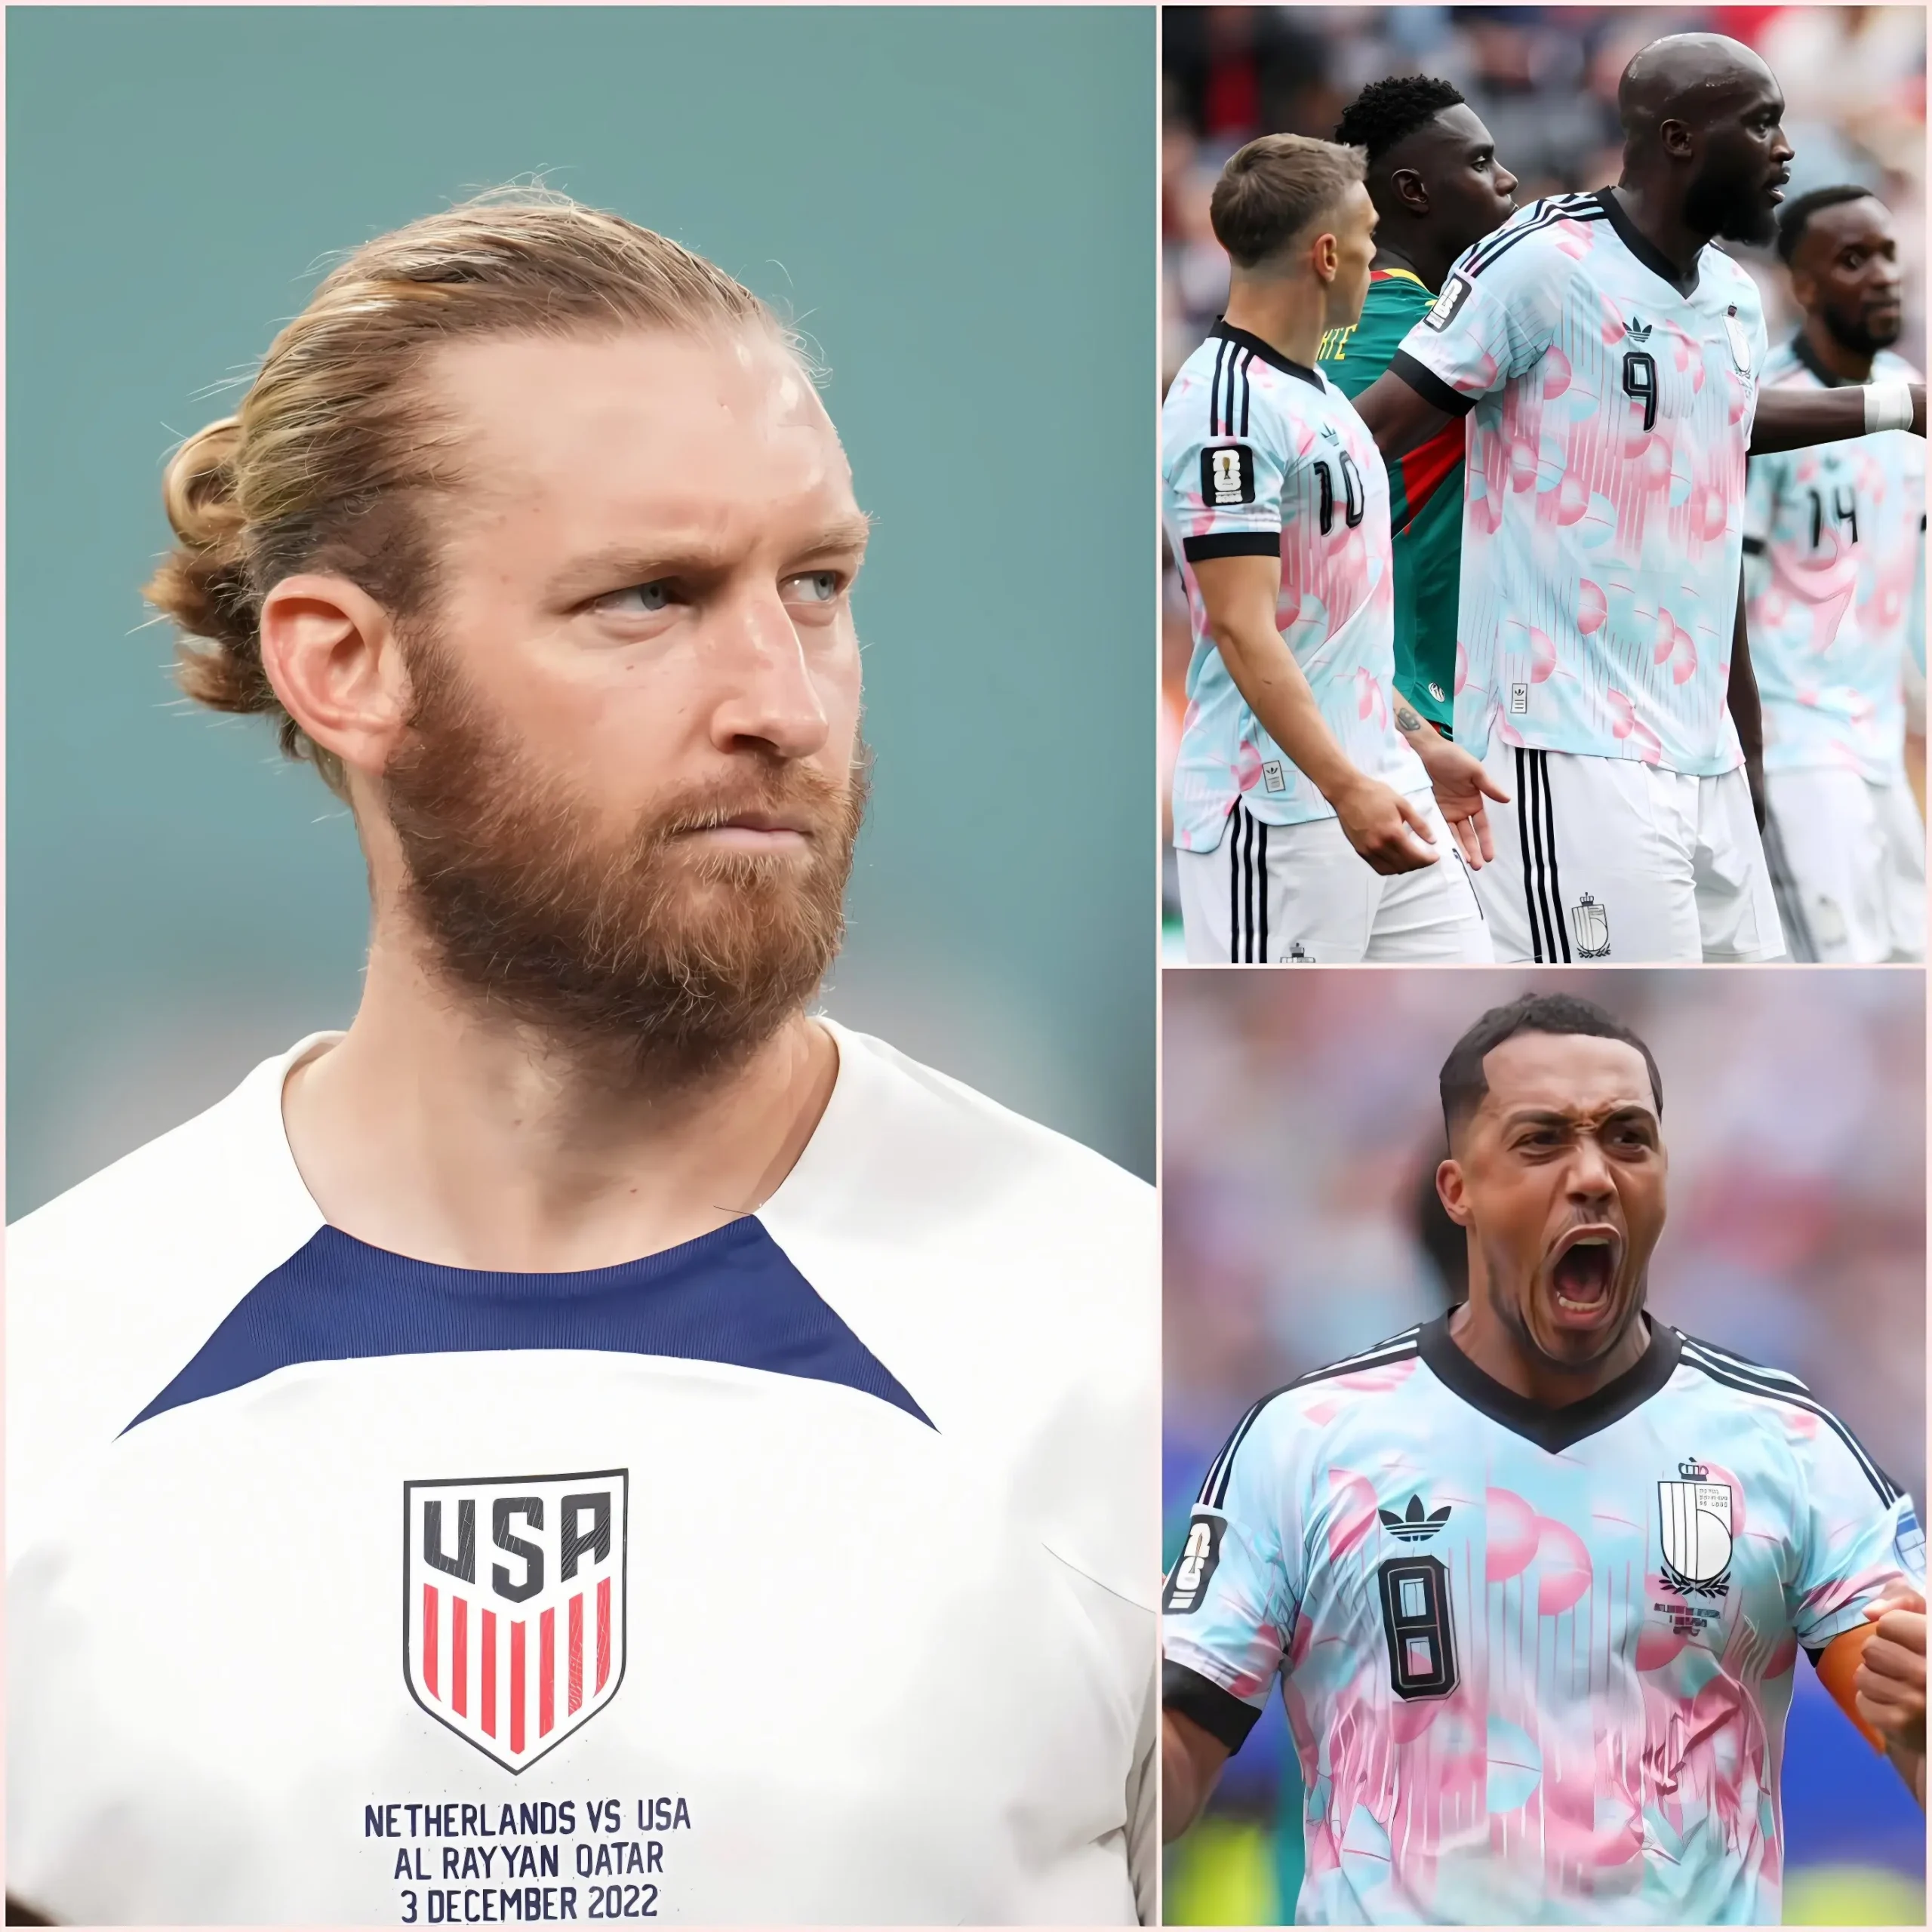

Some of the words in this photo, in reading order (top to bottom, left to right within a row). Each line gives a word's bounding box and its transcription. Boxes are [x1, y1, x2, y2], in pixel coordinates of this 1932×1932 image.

[1622, 352, 1659, 432] 9
[1313, 451, 1364, 537] 10
[1808, 486, 1859, 549] 14
[423, 1491, 611, 1604] USA
[1378, 1555, 1460, 1703] 8
[365, 1802, 575, 1838] NETHERLANDS
[586, 1799, 620, 1834] VS
[638, 1797, 691, 1831] USA
[394, 1847, 432, 1880] AL
[442, 1844, 558, 1879] RAYYAN
[576, 1841, 663, 1878] QATAR
[401, 1890, 417, 1924] 3
[428, 1887, 577, 1924] DECEMBER
[588, 1884, 658, 1918] 2022
